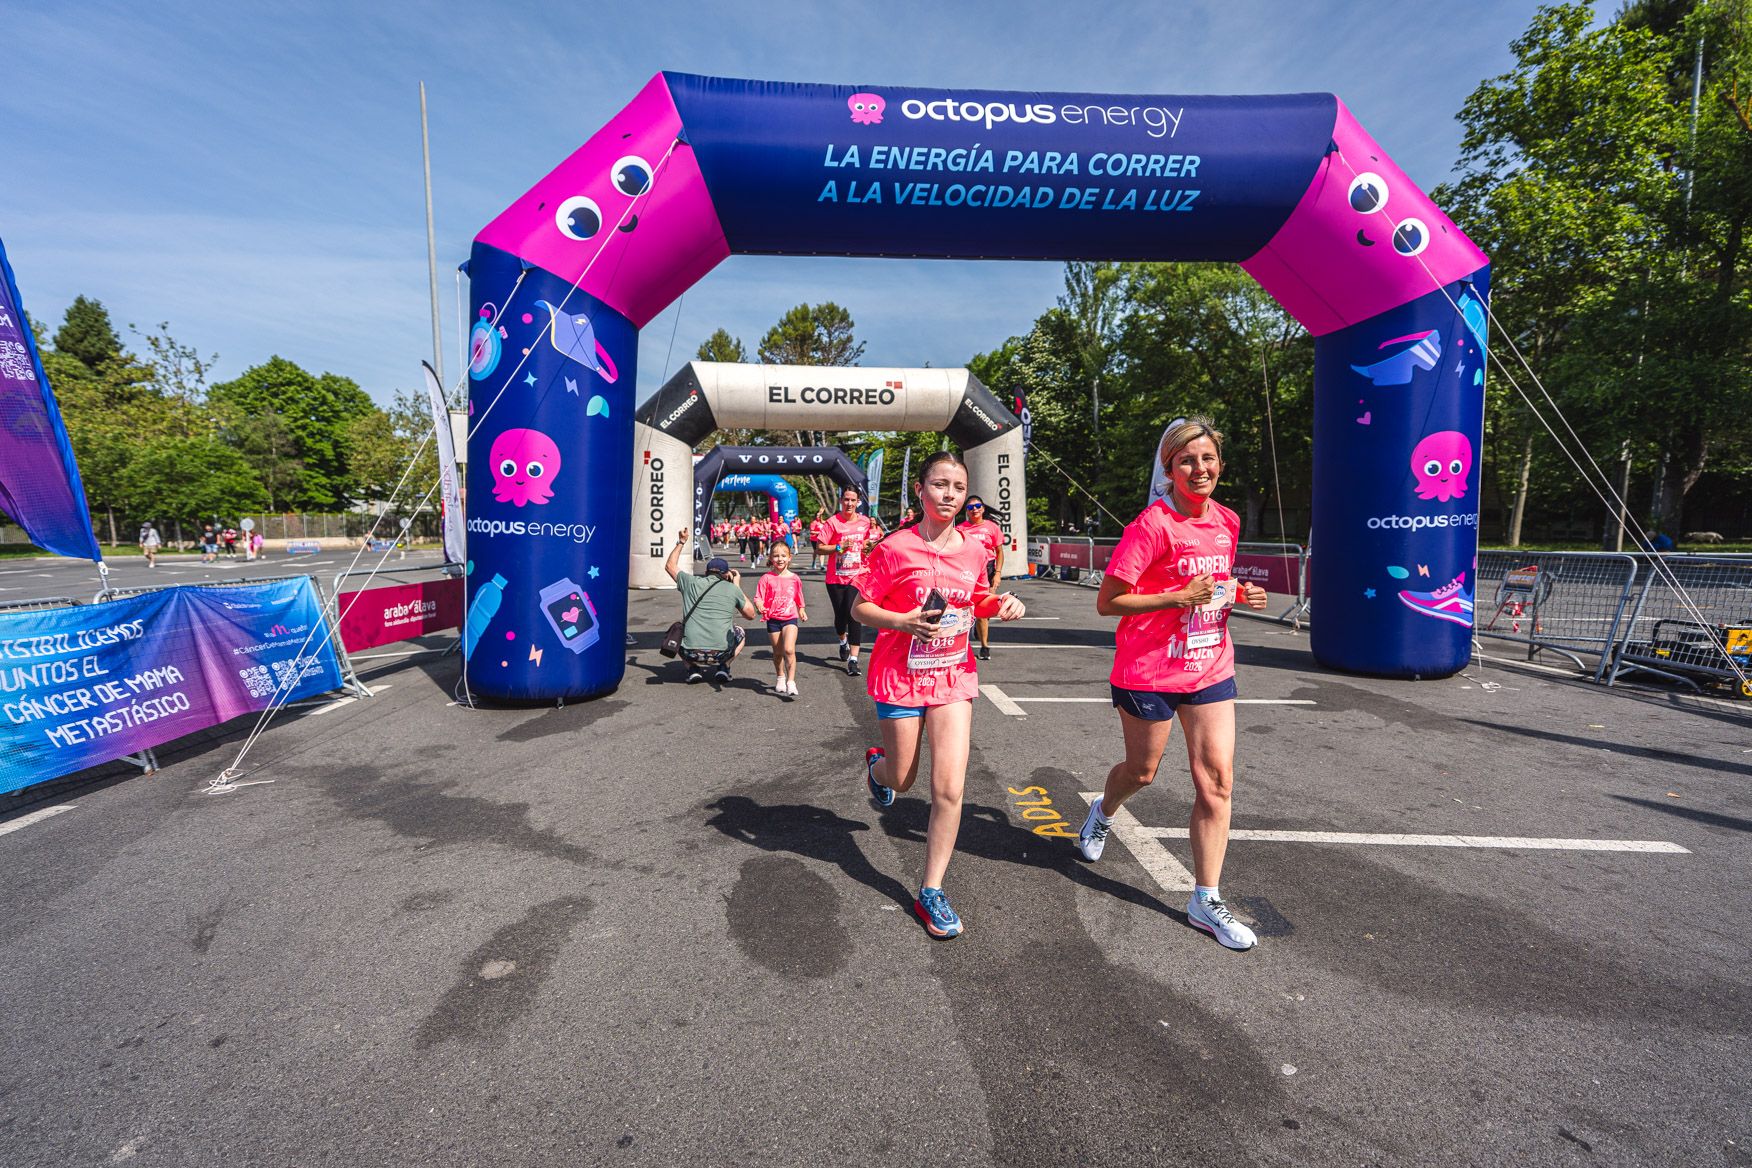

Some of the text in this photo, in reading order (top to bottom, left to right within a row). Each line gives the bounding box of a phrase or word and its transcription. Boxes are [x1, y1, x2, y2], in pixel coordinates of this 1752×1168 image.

[901, 98, 1184, 138] octopus energy
[824, 143, 1201, 179] LA ENERGÍA PARA CORRER
[818, 180, 1201, 212] A LA VELOCIDAD DE LA LUZ
[769, 386, 895, 405] EL CORREO
[660, 394, 699, 430] EL CORREO
[965, 397, 999, 432] EL CORREO
[738, 454, 824, 464] VOLVO
[650, 457, 664, 558] EL CORREO
[998, 454, 1012, 546] EL CORREO
[694, 486, 703, 550] VOLVO
[1367, 513, 1448, 532] octopus
[467, 517, 597, 544] octopus energy
[912, 569, 941, 577] OYSHO
[1177, 555, 1230, 576] CARRERA
[916, 586, 971, 605] CARERA
[384, 600, 436, 619] araba álava
[1203, 610, 1222, 622] 016
[932, 636, 955, 647] 016
[83, 656, 109, 678] EL
[1184, 661, 1203, 672] 2026
[917, 677, 935, 687] 2026
[3, 665, 185, 724] CÁNCER DE MAMA
[44, 692, 191, 748] METASTÁSICO
